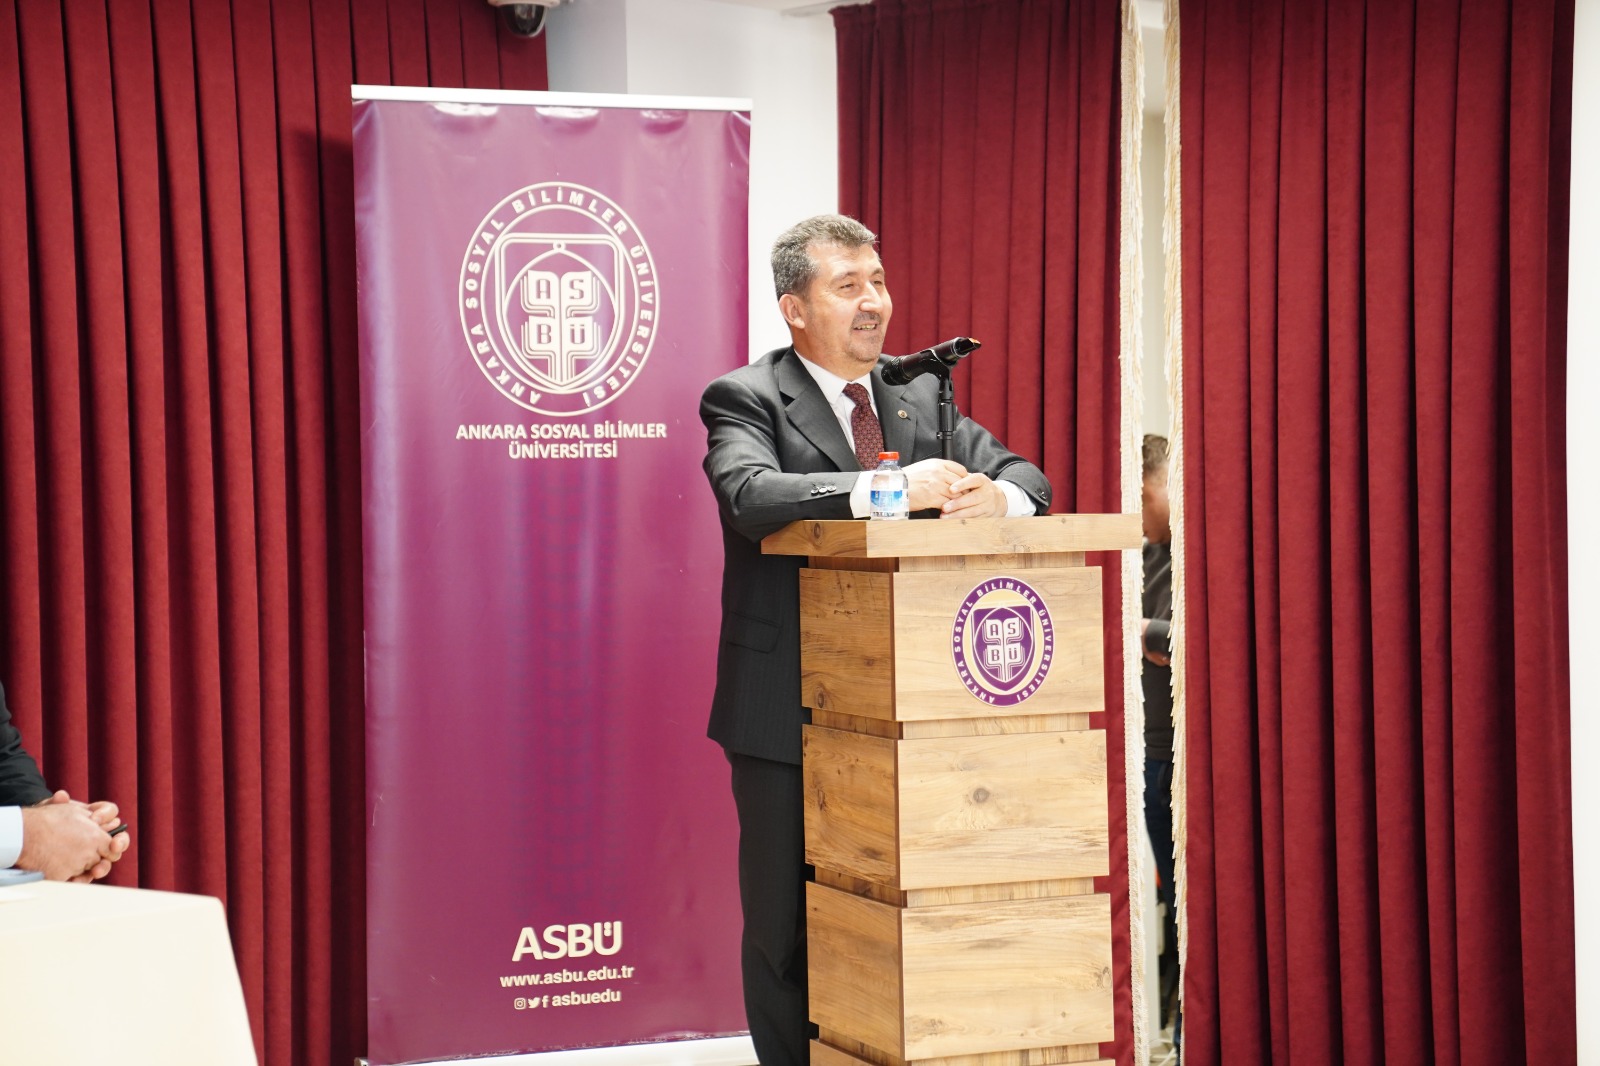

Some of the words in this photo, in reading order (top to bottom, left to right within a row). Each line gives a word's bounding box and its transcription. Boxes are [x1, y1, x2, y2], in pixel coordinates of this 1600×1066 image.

[511, 186, 628, 235] BİLİMLER
[465, 218, 504, 309] SOSYAL
[583, 245, 655, 408] ÜNİVERSİTESİ
[470, 323, 541, 405] ANKARA
[456, 424, 527, 440] ANKARA
[530, 424, 590, 439] SOSYAL
[594, 420, 667, 438] BİLİMLER
[508, 440, 618, 459] ÜNİVERSİTESİ
[976, 580, 1037, 604] BİLİMLER
[953, 601, 973, 652] SOSYAL
[1016, 609, 1052, 703] ÜNİVERSİTESİ
[957, 660, 995, 704] ANKARA
[511, 920, 622, 962] ASBÜ
[500, 965, 635, 988] www.asbu.edu.tr
[551, 988, 622, 1007] asbuedu
